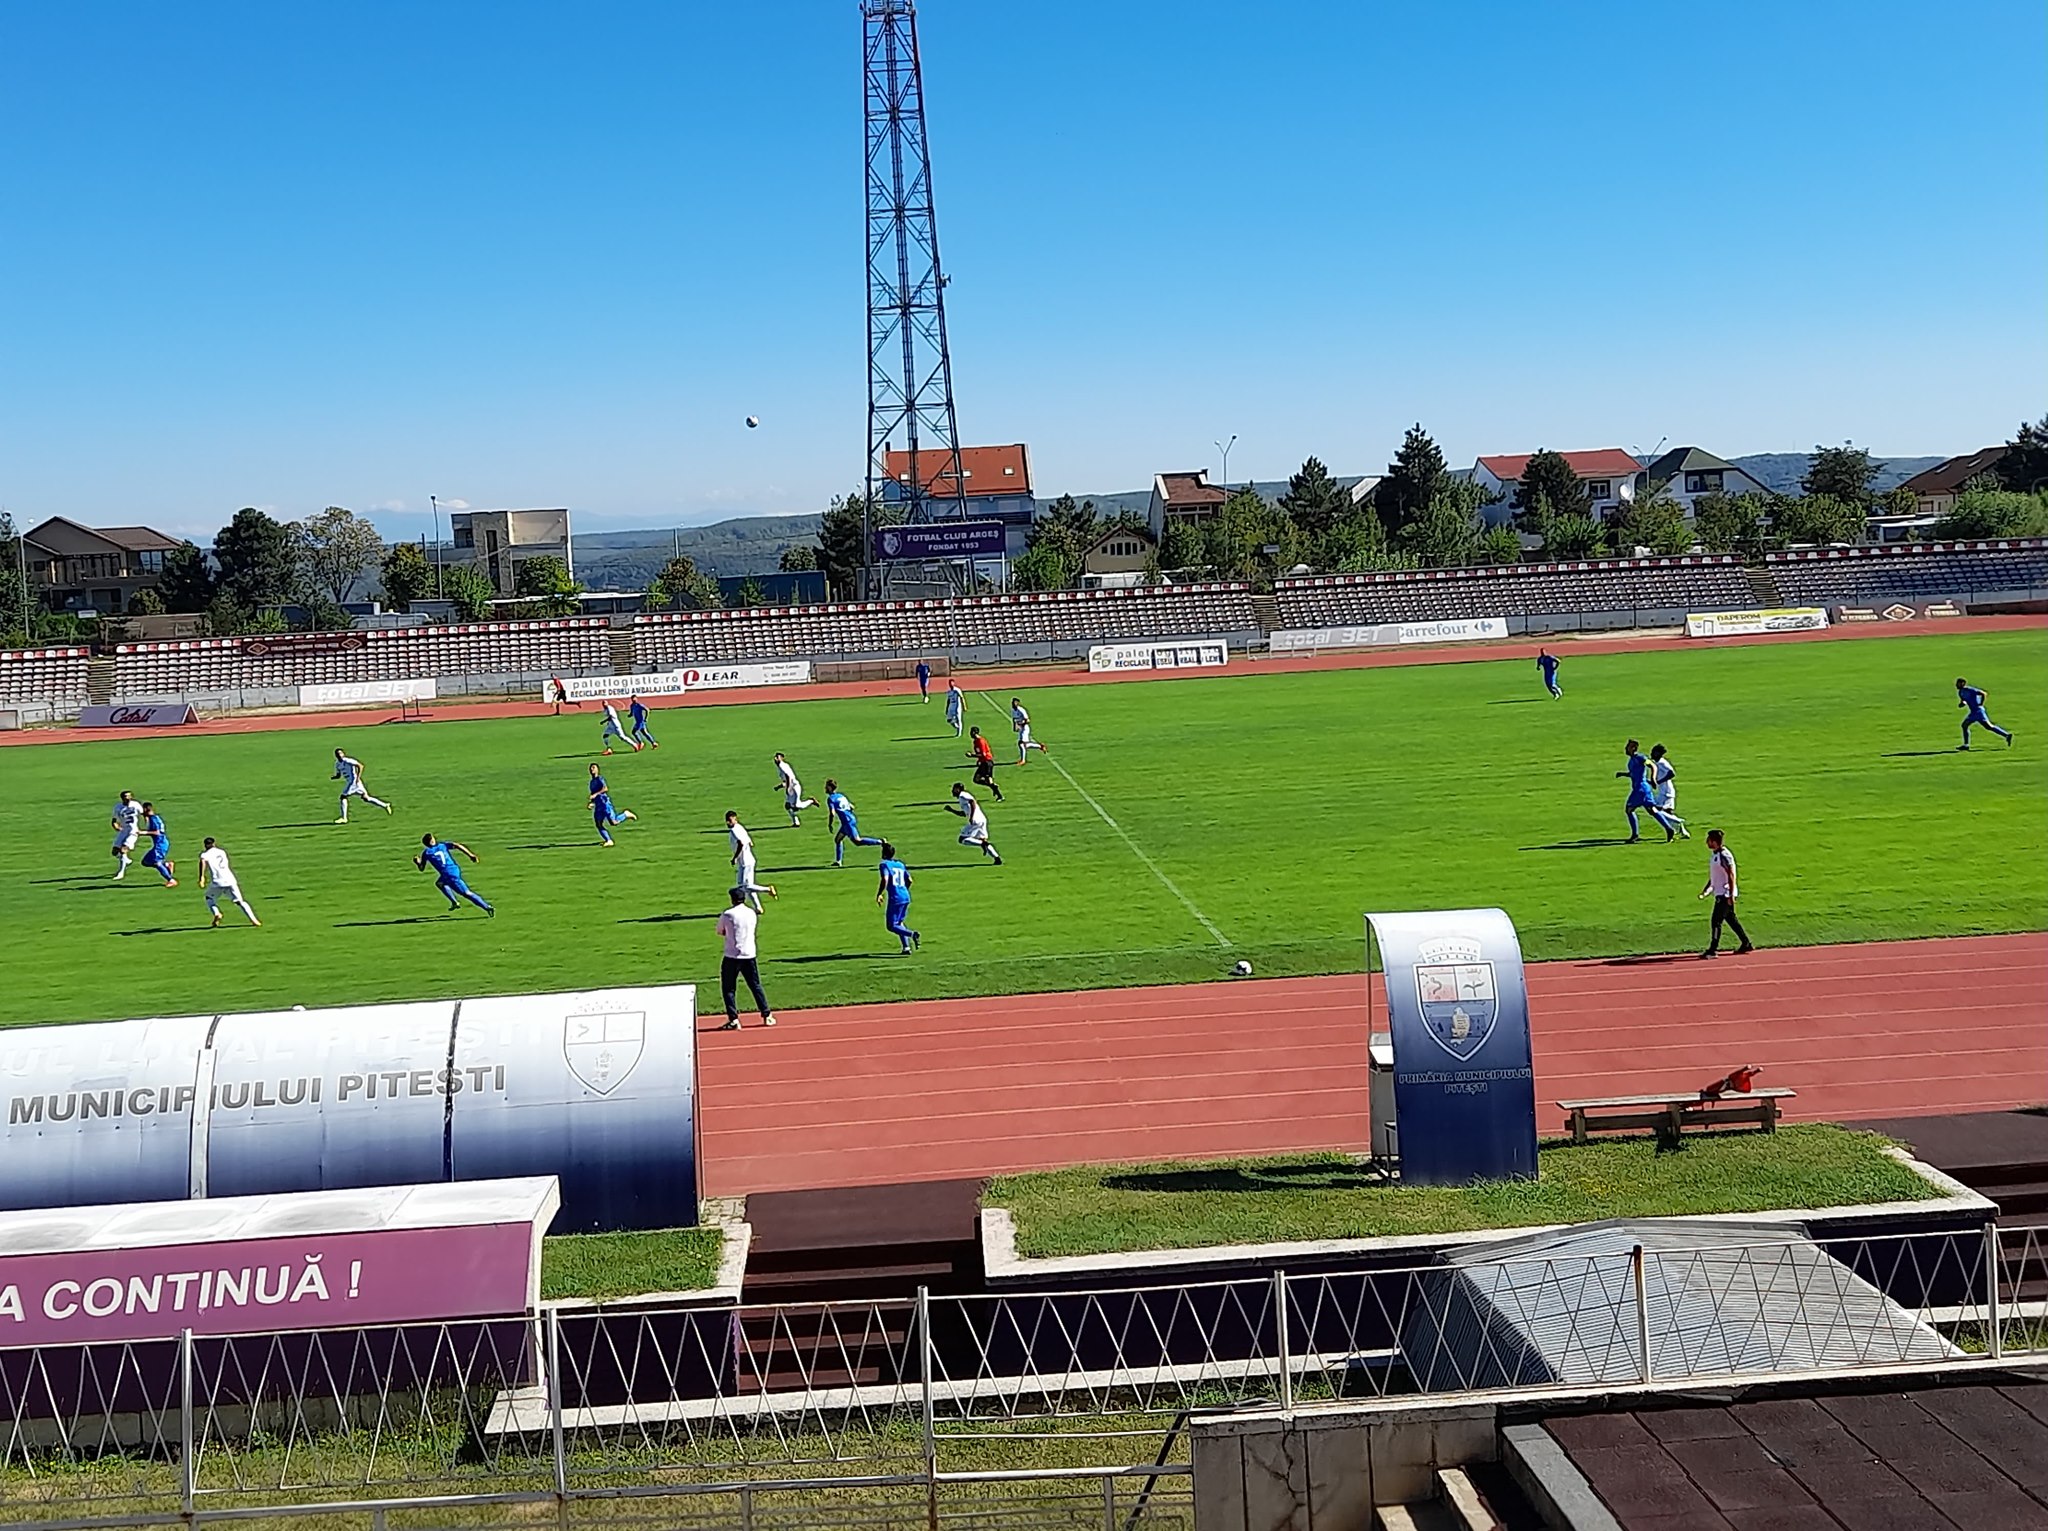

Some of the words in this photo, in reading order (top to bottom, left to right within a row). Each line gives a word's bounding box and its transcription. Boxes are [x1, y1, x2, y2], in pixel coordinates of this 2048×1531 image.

[907, 534, 942, 542] FOTBAL
[943, 532, 967, 540] CLUB
[928, 543, 959, 551] FONDAT
[572, 675, 679, 690] paletlogistic.ro
[703, 671, 739, 681] LEAR
[216, 855, 226, 869] 2
[434, 850, 446, 865] 7
[1454, 1067, 1531, 1082] MUNICIPIULUI
[9, 1076, 323, 1126] MUNICIPIULUI
[42, 1253, 331, 1320] CONTINUĂ
